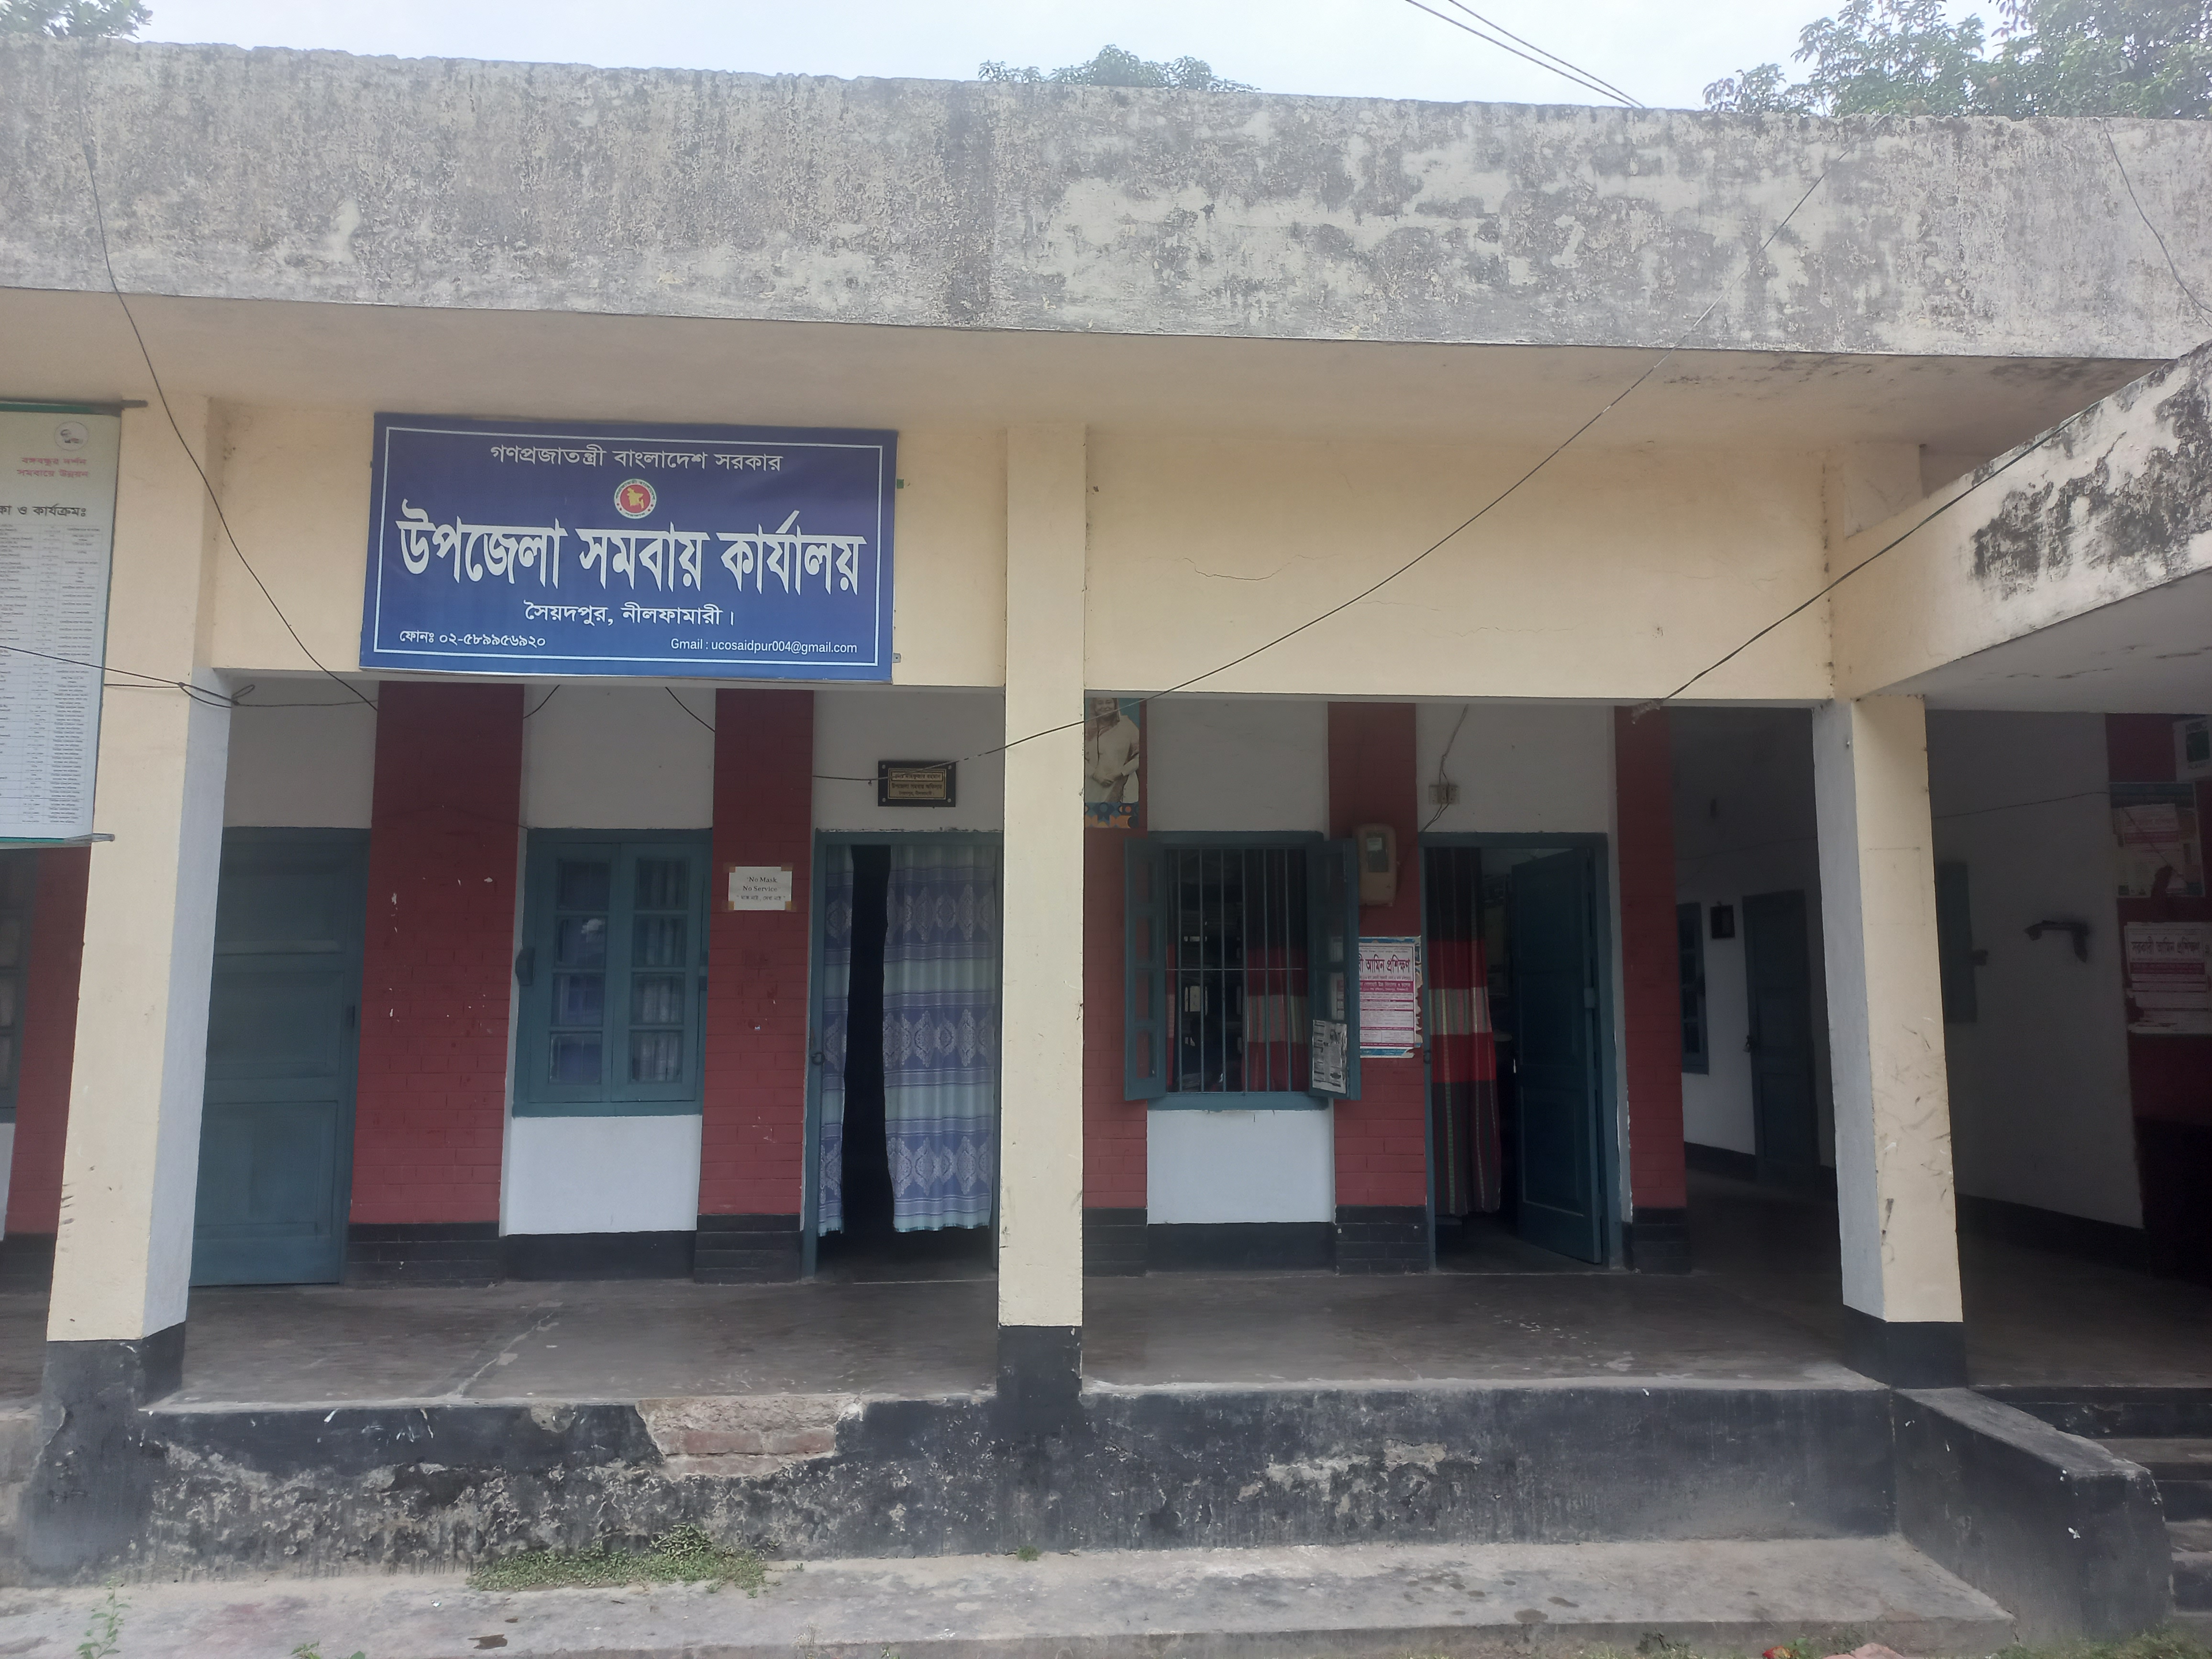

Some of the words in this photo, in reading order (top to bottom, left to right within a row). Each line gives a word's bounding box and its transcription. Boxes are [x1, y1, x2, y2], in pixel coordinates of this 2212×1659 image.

[491, 443, 607, 466] গণপ্রজাতন্ত্রী
[612, 448, 708, 469] বাংলাদেশ
[714, 453, 784, 472] সরকার
[18, 506, 27, 515] ও
[32, 503, 87, 517] কার্যক্রমঃ
[396, 498, 568, 589] উপজেলা
[575, 521, 710, 592] সমবায়
[716, 509, 867, 596] কার্যালয়
[524, 599, 614, 626] সৈয়দপুর,
[439, 632, 546, 648] ০২-৫৮৯৯৫৬৯২০
[711, 640, 858, 654] ucosaidpur004@gmail.com
[1365, 953, 1385, 973] আমিন
[1386, 954, 1411, 974] প্রশিক্ষণ
